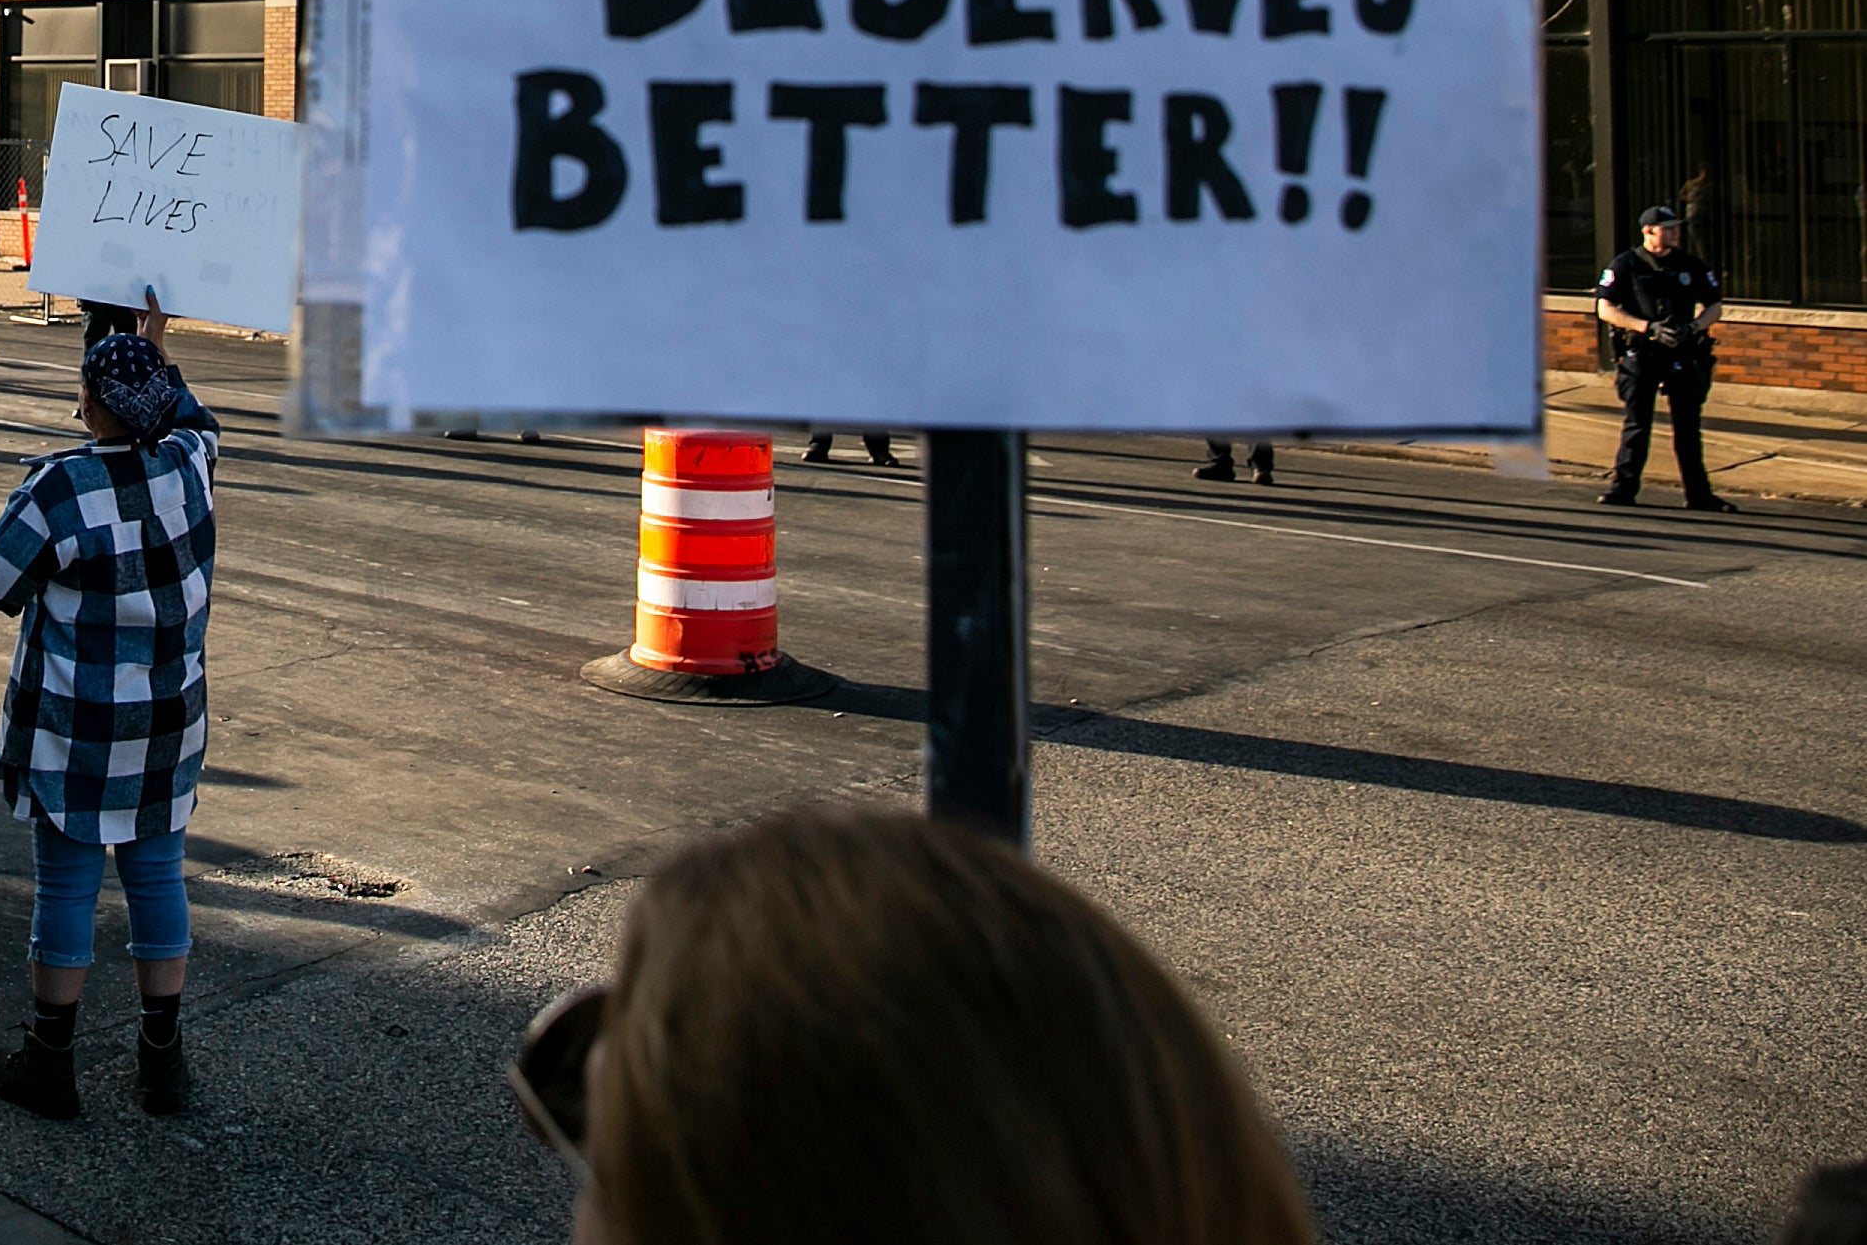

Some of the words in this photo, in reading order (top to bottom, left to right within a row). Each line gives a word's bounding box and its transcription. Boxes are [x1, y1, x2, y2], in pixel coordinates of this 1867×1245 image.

[88, 114, 214, 176] SAVE
[513, 68, 1389, 233] BETTER!!
[92, 180, 208, 234] LIVES
